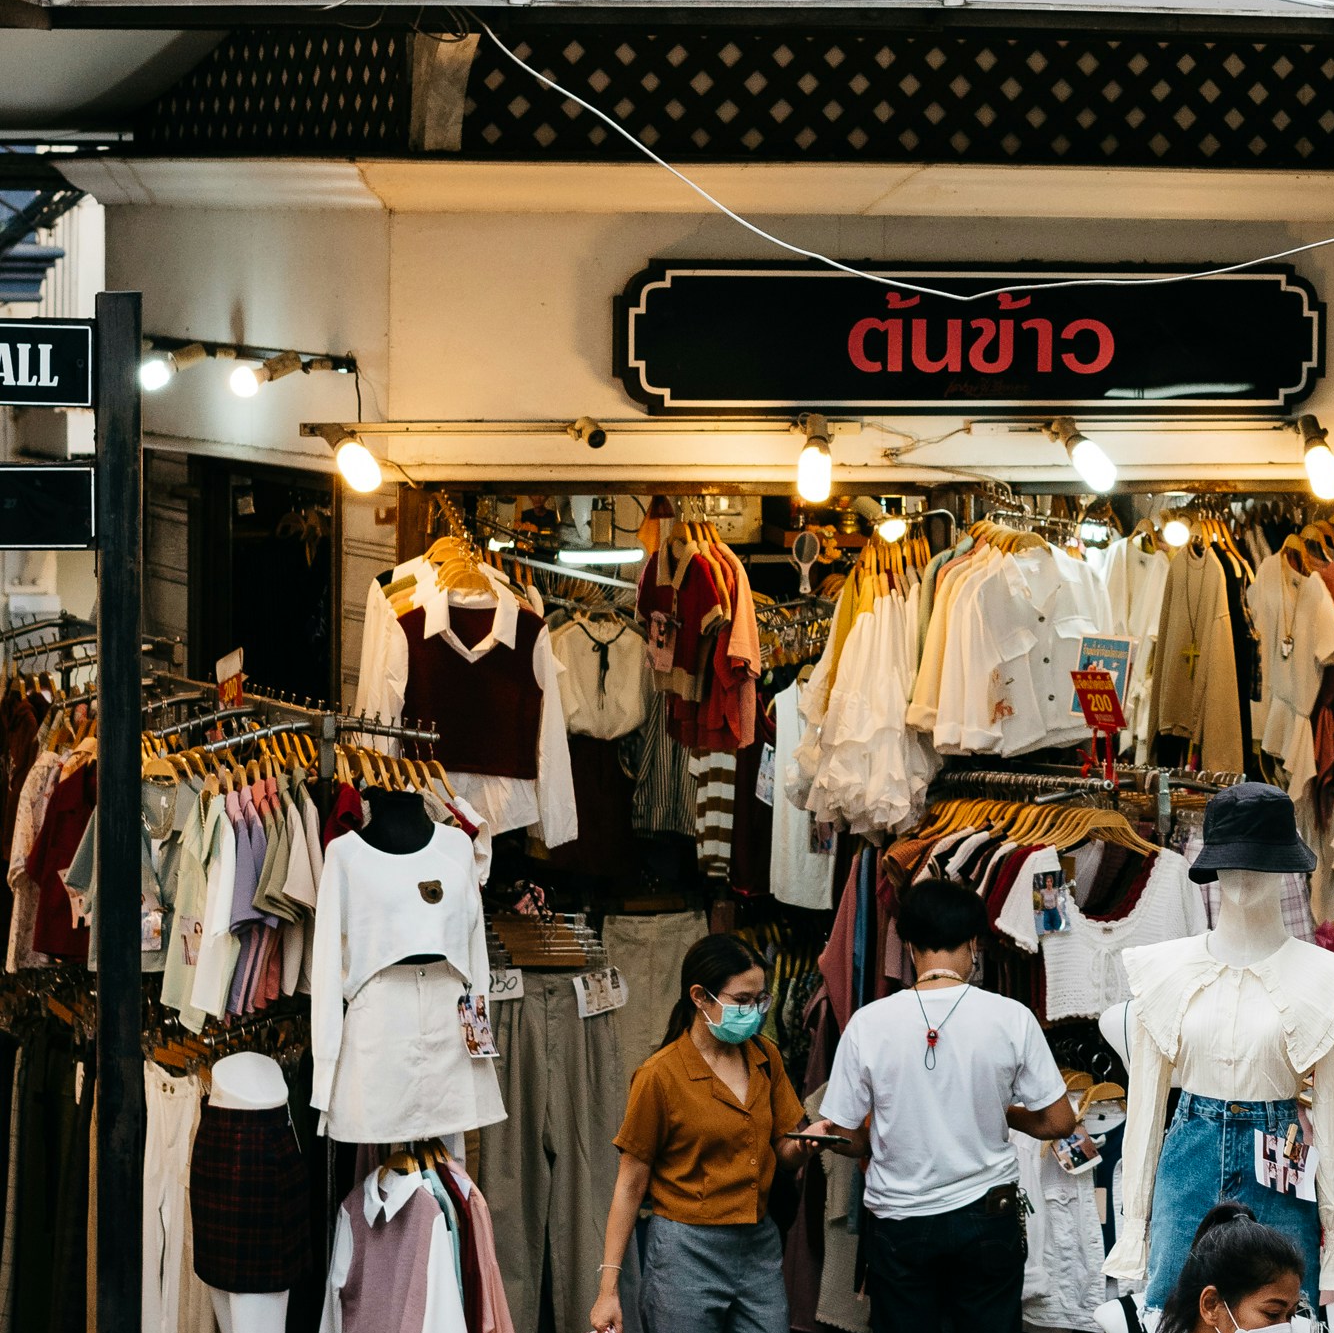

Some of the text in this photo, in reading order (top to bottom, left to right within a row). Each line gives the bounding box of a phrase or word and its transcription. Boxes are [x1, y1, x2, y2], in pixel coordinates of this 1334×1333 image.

[848, 291, 1116, 374] ต้นข้าว
[1087, 693, 1113, 712] 200
